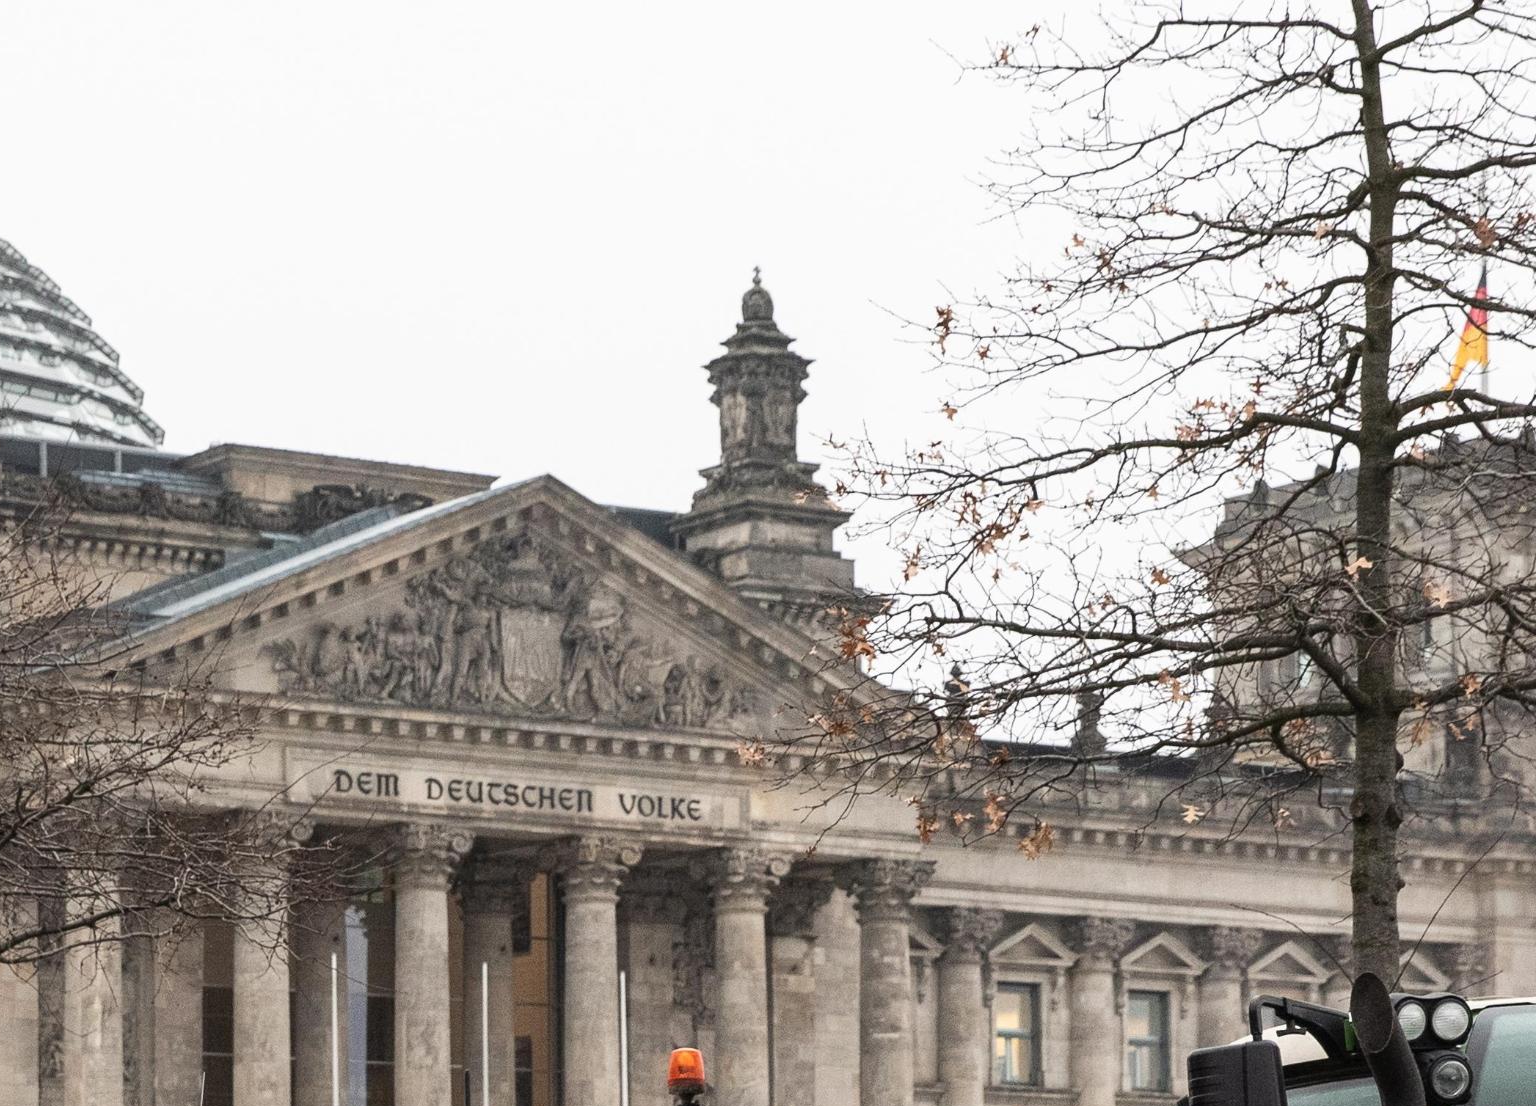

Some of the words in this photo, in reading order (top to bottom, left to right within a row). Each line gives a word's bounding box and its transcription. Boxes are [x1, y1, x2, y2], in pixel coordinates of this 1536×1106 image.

[333, 769, 400, 797] DEM
[425, 777, 593, 813] DEUTSCHEN
[618, 793, 702, 821] VOLKE
